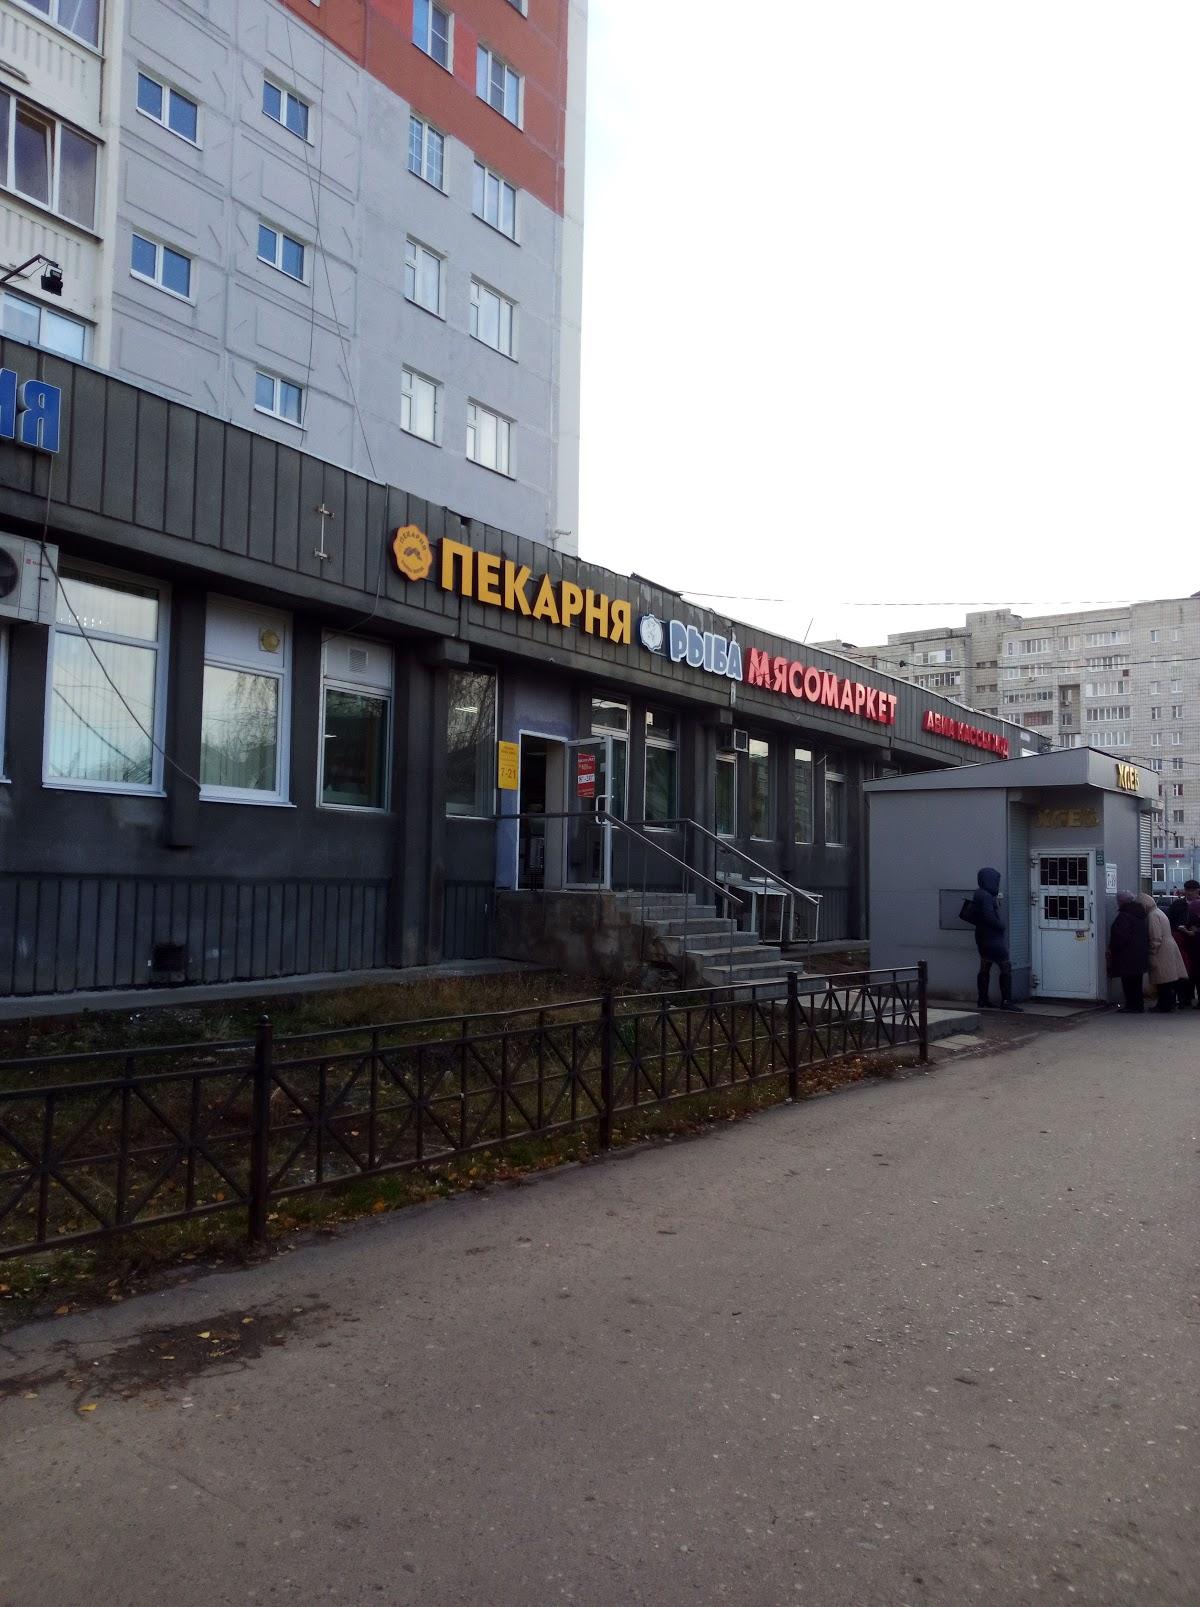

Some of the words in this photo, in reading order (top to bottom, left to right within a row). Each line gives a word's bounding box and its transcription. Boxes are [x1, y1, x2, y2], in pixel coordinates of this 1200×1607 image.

[440, 537, 632, 645] ПЕКАРНЯ
[669, 619, 743, 682] РЫБА
[746, 647, 898, 725] МЯСОМАРКЕТ
[1116, 763, 1140, 791] ХЛЕБ
